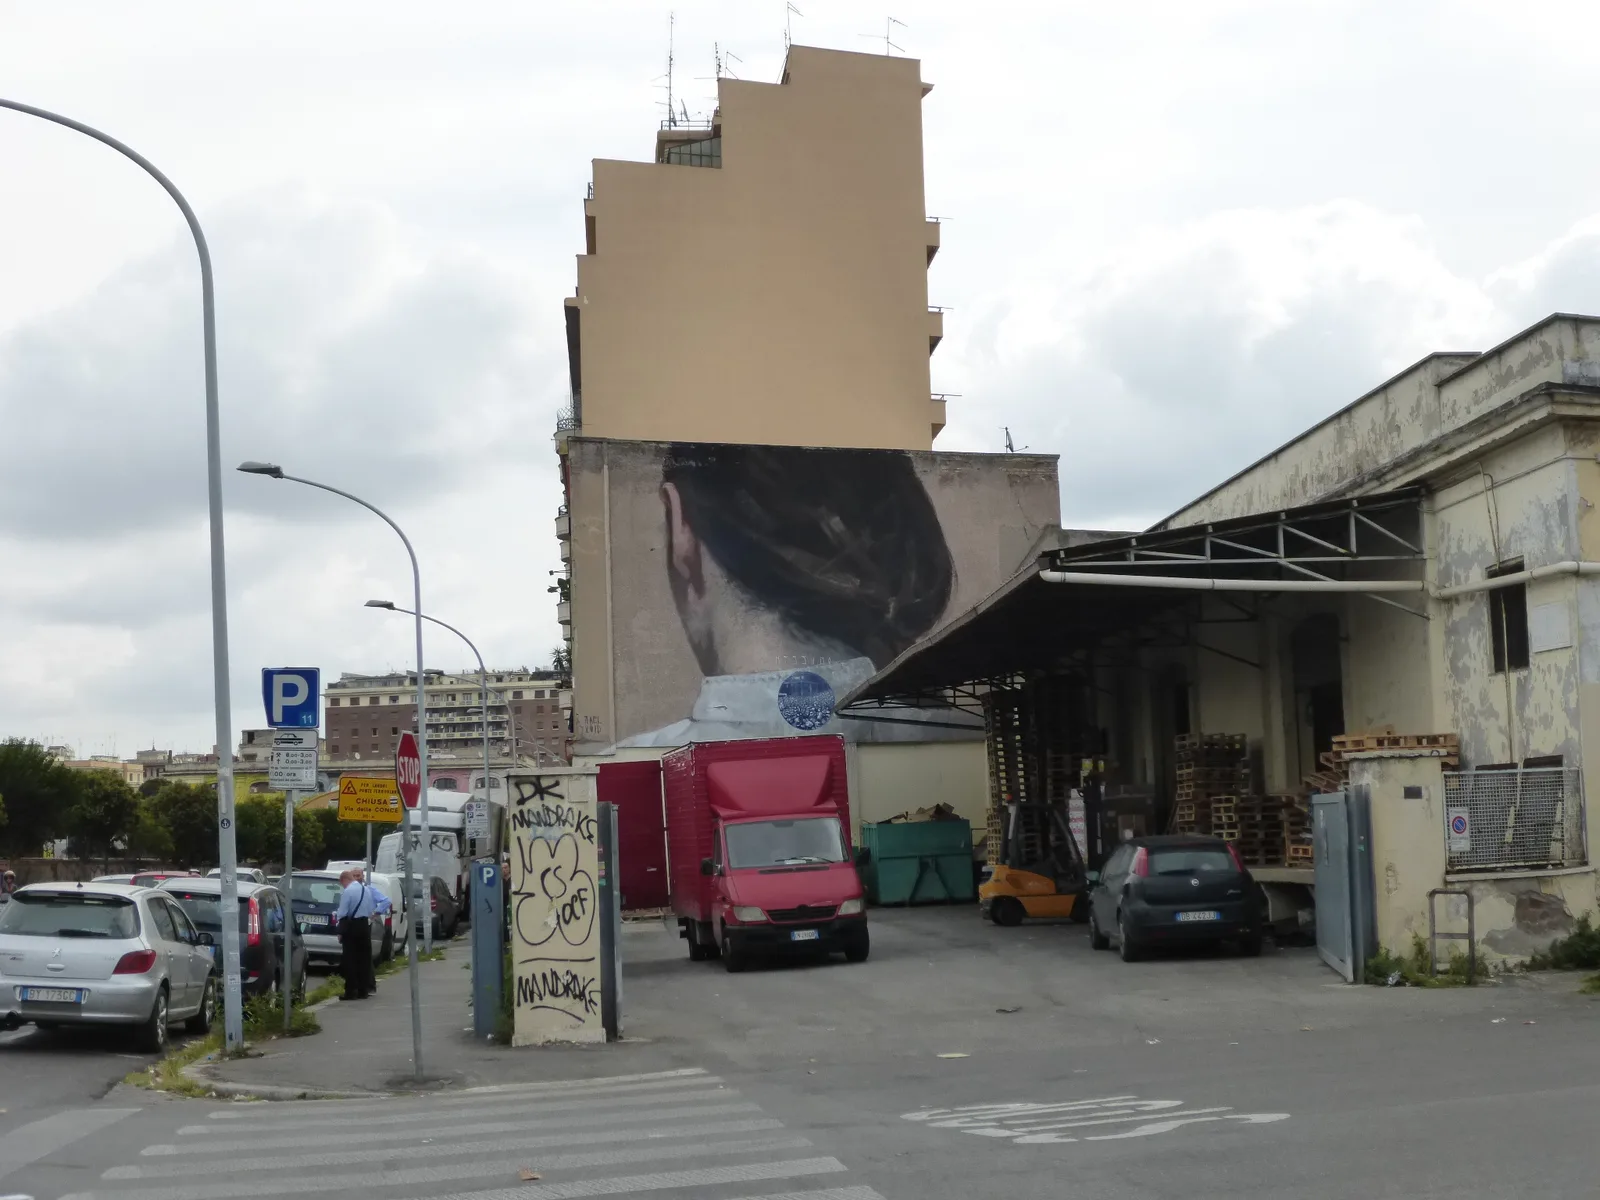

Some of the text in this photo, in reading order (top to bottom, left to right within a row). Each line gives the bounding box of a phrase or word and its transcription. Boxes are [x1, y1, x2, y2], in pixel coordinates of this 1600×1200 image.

[272, 674, 309, 723] P
[302, 714, 313, 724] 11
[399, 756, 419, 784] STOP
[356, 797, 388, 805] CHIUSA
[514, 775, 564, 806] DK
[483, 867, 494, 884] P
